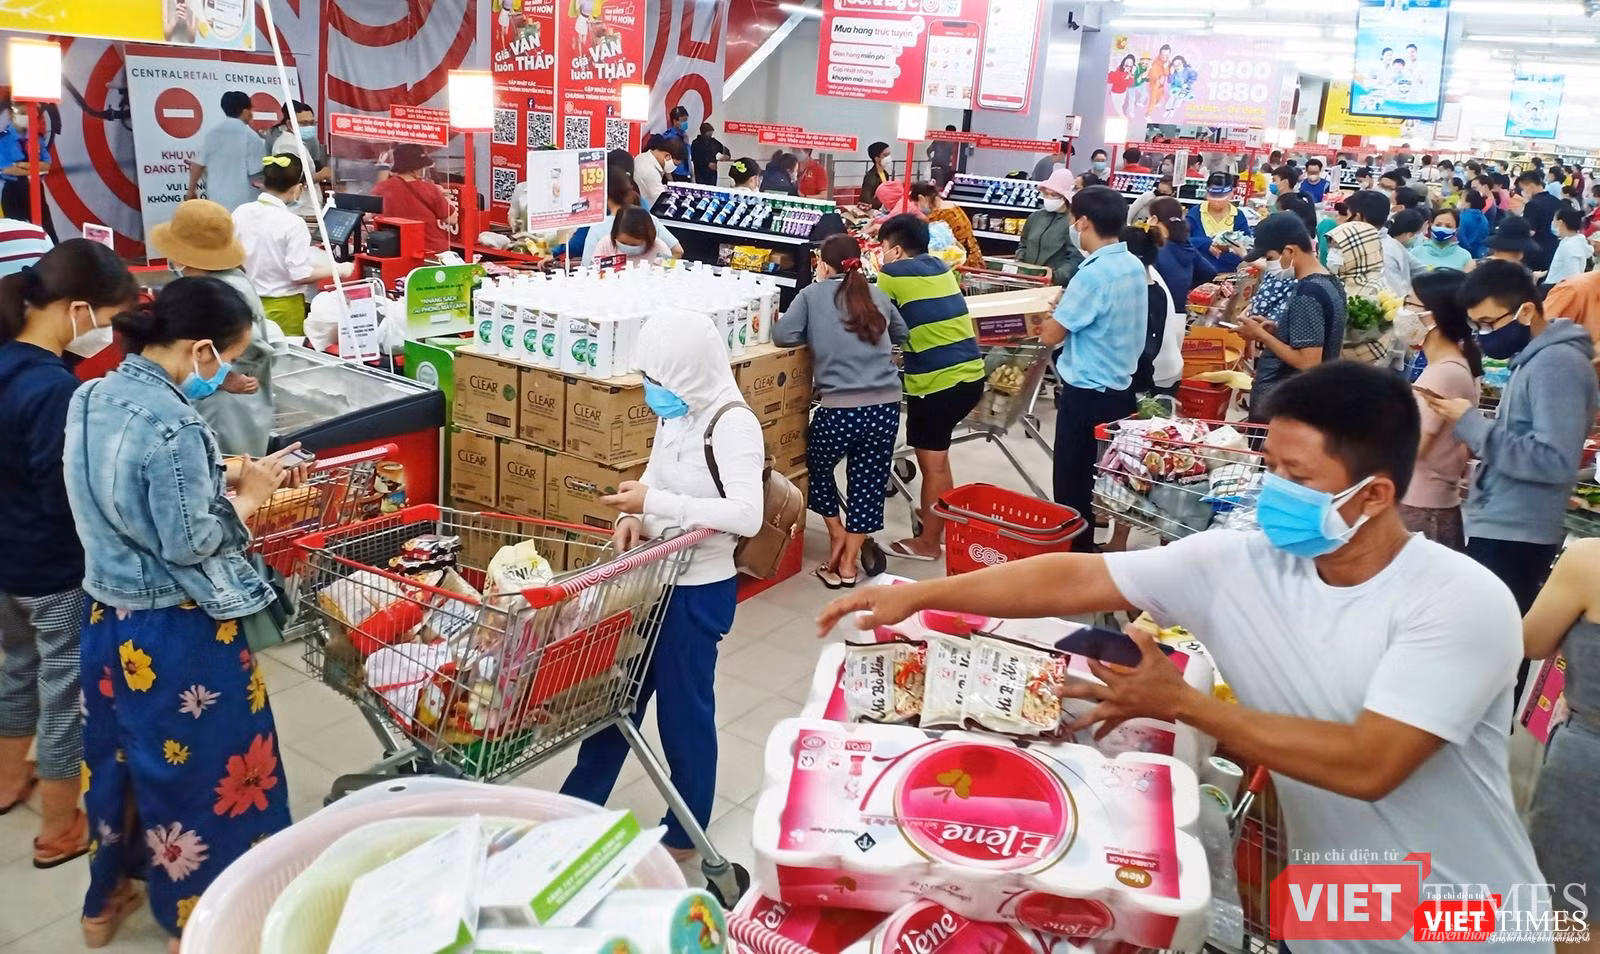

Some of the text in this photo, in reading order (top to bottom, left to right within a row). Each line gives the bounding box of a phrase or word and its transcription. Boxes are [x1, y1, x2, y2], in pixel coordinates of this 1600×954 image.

[834, 24, 852, 33] Mua
[494, 50, 555, 72] luôn THẤP
[495, 50, 511, 62] Giá
[131, 68, 219, 81] CENTRALRETAIL
[594, 57, 637, 80] THẤP
[1209, 60, 1272, 80] 1900
[225, 73, 297, 87] CENTRALRETIL
[1207, 82, 1269, 103] 1880
[161, 151, 184, 160] KHU
[144, 164, 176, 174] ĐANG
[581, 167, 604, 185] 139
[166, 183, 182, 191] VUI
[147, 192, 181, 203] KHÔNG
[469, 375, 499, 394] CLEAR
[754, 375, 775, 391] CLEAR
[527, 390, 555, 409] CLEAR
[573, 402, 601, 421] CLEAR
[780, 430, 801, 446] CLEAR
[457, 449, 487, 467] CLEAR
[507, 461, 537, 480] CLEAR
[943, 822, 1053, 860] Elène
[1109, 855, 1157, 869] JUMBO PACK
[1119, 871, 1145, 884] New
[895, 912, 957, 954] lène
